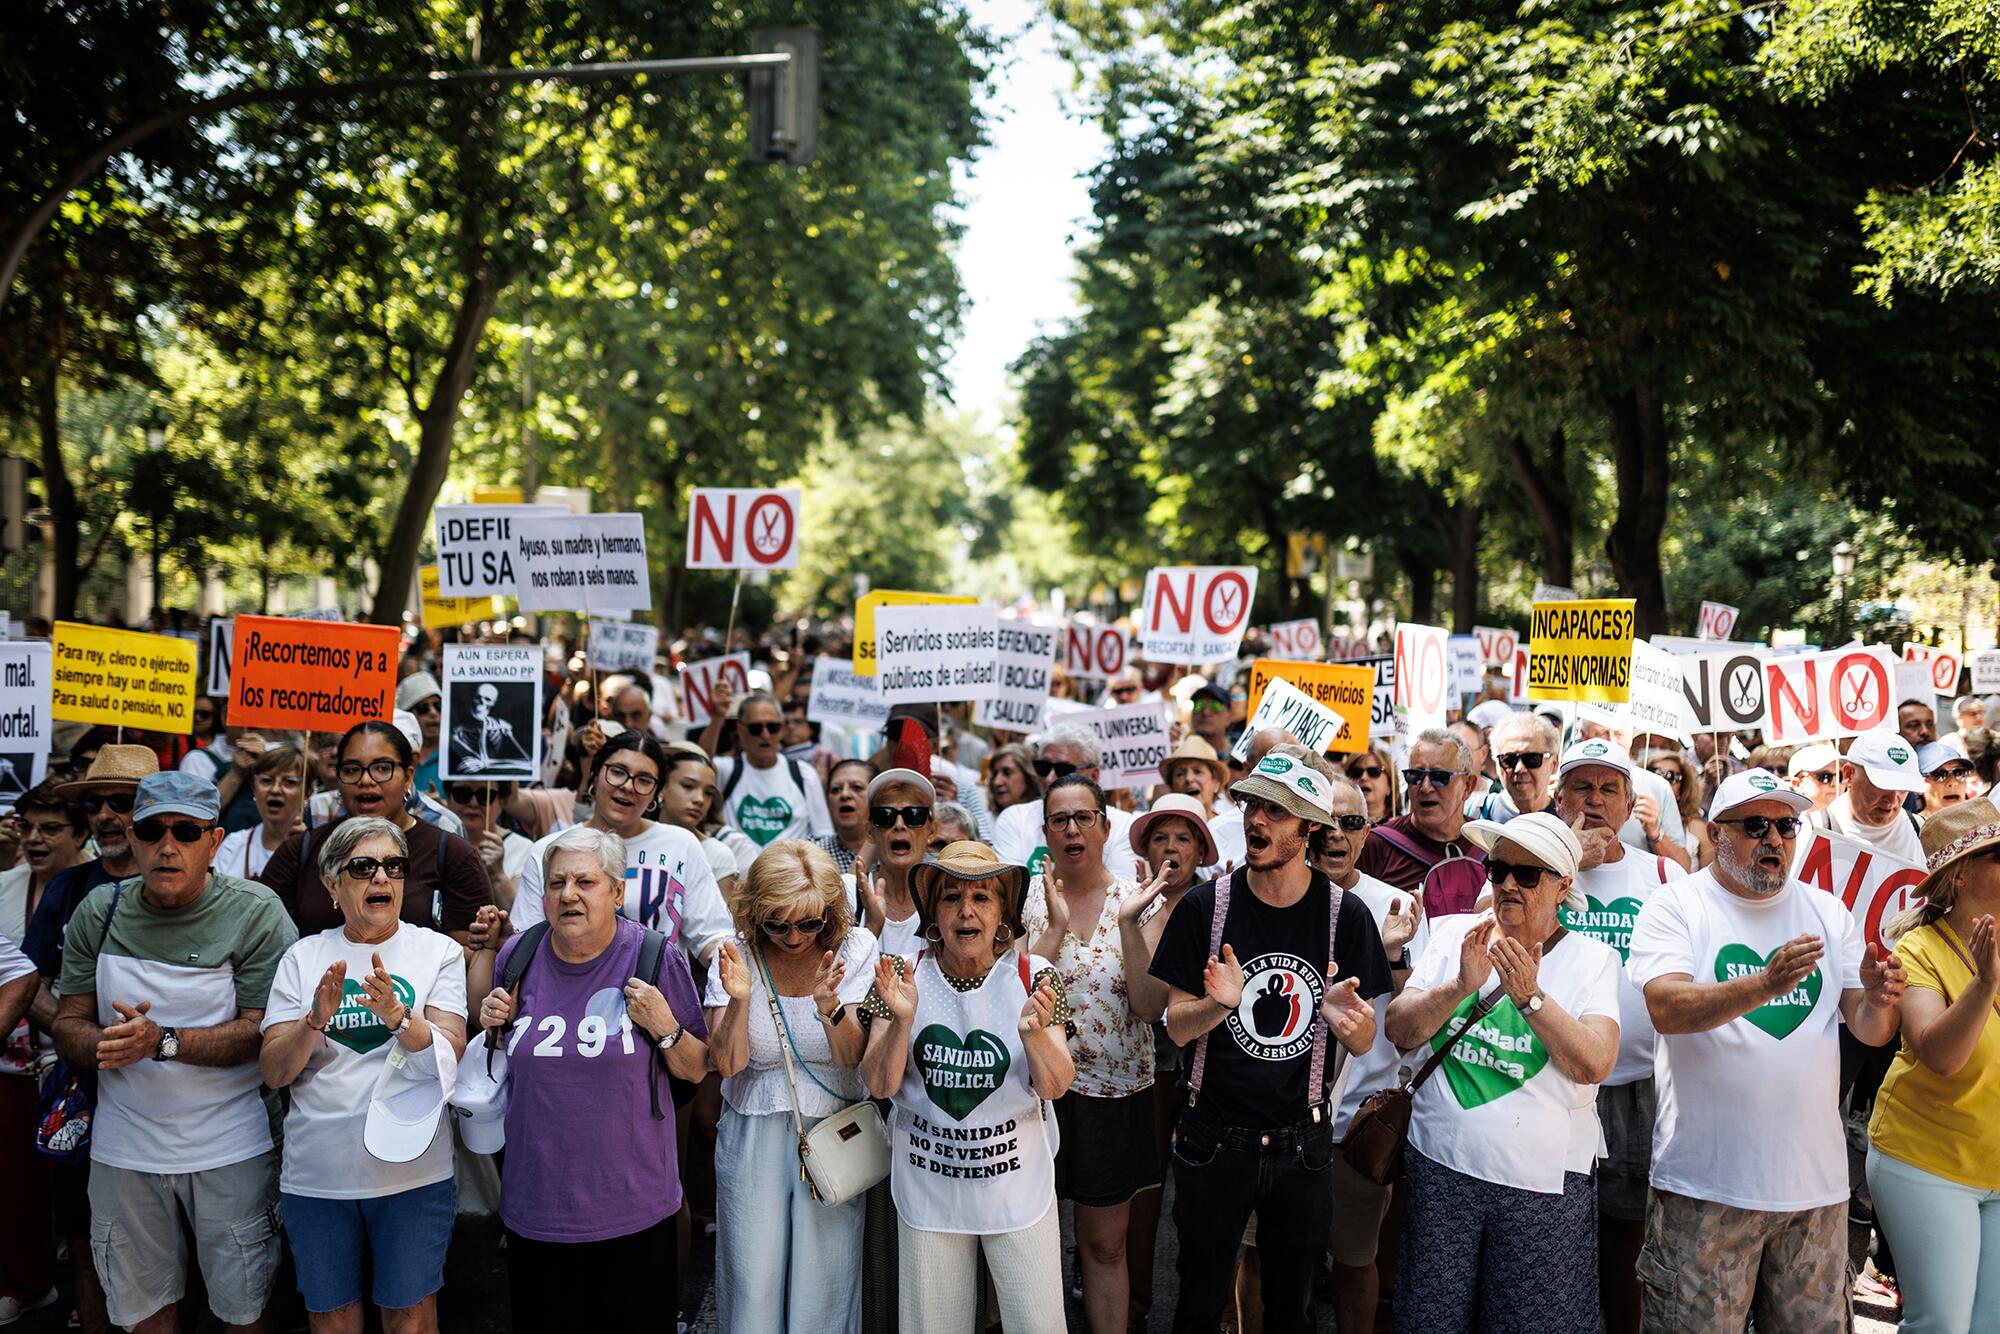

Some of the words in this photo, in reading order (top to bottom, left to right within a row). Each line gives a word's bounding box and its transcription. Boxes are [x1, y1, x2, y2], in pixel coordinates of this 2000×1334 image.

[693, 494, 794, 564] NO
[519, 535, 551, 561] Ayuso,
[552, 541, 563, 556] su
[565, 533, 593, 557] madre
[594, 540, 601, 560] y
[602, 533, 644, 556] hermano,
[442, 552, 474, 587] TU
[482, 551, 516, 586] SA
[532, 571, 549, 588] nos
[551, 566, 577, 588] roban
[579, 573, 585, 586] a
[587, 565, 605, 585] seis
[607, 568, 638, 586] manos.
[1152, 572, 1249, 635] NO
[1271, 620, 1317, 654] NO
[1533, 609, 1633, 640] INCAPACES?
[1702, 607, 1732, 638] NO
[56, 642, 83, 661] Para
[86, 650, 106, 667] rey,
[109, 650, 137, 667] clero
[140, 657, 147, 669] o
[149, 654, 190, 675] ejército
[243, 631, 350, 669] ¡Recortemos
[354, 650, 373, 679] ya
[378, 652, 388, 673] a
[456, 648, 480, 661] AÚN
[486, 650, 530, 661] ESPERA
[880, 629, 943, 660] ¡Servicios
[946, 626, 994, 649] sociales
[998, 629, 1052, 656] EFIENDE
[1067, 626, 1124, 675] NO
[5, 654, 35, 687] mal.
[55, 667, 104, 688] siempre
[107, 672, 128, 692] hay
[131, 677, 146, 691] un
[149, 677, 188, 697] dinero.
[451, 666, 466, 677] LA
[469, 666, 516, 677] SANIDAD
[520, 666, 535, 677] PP
[882, 664, 933, 696] públicos
[937, 666, 951, 686] de
[954, 661, 996, 685] calidad!
[1005, 666, 1046, 690] BOLSA
[1394, 630, 1443, 713] NO
[1529, 655, 1569, 684] ESTAS
[1571, 656, 1631, 687] NORMAS!
[53, 689, 77, 706] Para
[80, 693, 110, 711] salud
[112, 700, 119, 711] o
[122, 699, 164, 719] pensión,
[167, 702, 186, 719] NO.
[240, 677, 264, 708] los
[269, 686, 385, 718] recortadores!
[683, 660, 748, 723] NO
[1316, 680, 1365, 706] servicios
[1682, 656, 1763, 725] NO
[1766, 653, 1890, 740] NO
[0, 704, 39, 738] ortal.
[984, 699, 992, 720] Y
[994, 700, 1041, 725] SALUD!
[1104, 714, 1164, 740] UNIVERSAL,
[1799, 838, 1929, 963] NO
[1251, 959, 1268, 973] LA
[1270, 956, 1298, 971] VIDA
[1299, 965, 1323, 1004] RURAL
[324, 1009, 385, 1032] PÚBLIC
[1229, 1015, 1250, 1046] ODIA
[1246, 1043, 1260, 1057] AL
[1446, 1016, 1532, 1053] Snidad
[923, 1043, 996, 1068] SANIDAD
[1450, 1039, 1525, 1079] ública
[925, 1064, 996, 1089] PÚBLICA
[912, 1114, 928, 1133] LA
[932, 1119, 1017, 1142] SANIDAD
[910, 1133, 931, 1151] NO
[935, 1142, 954, 1160] SE
[955, 1138, 1018, 1161] VENDE
[909, 1152, 926, 1169] SE
[930, 1157, 1021, 1179] DEFIENDE
